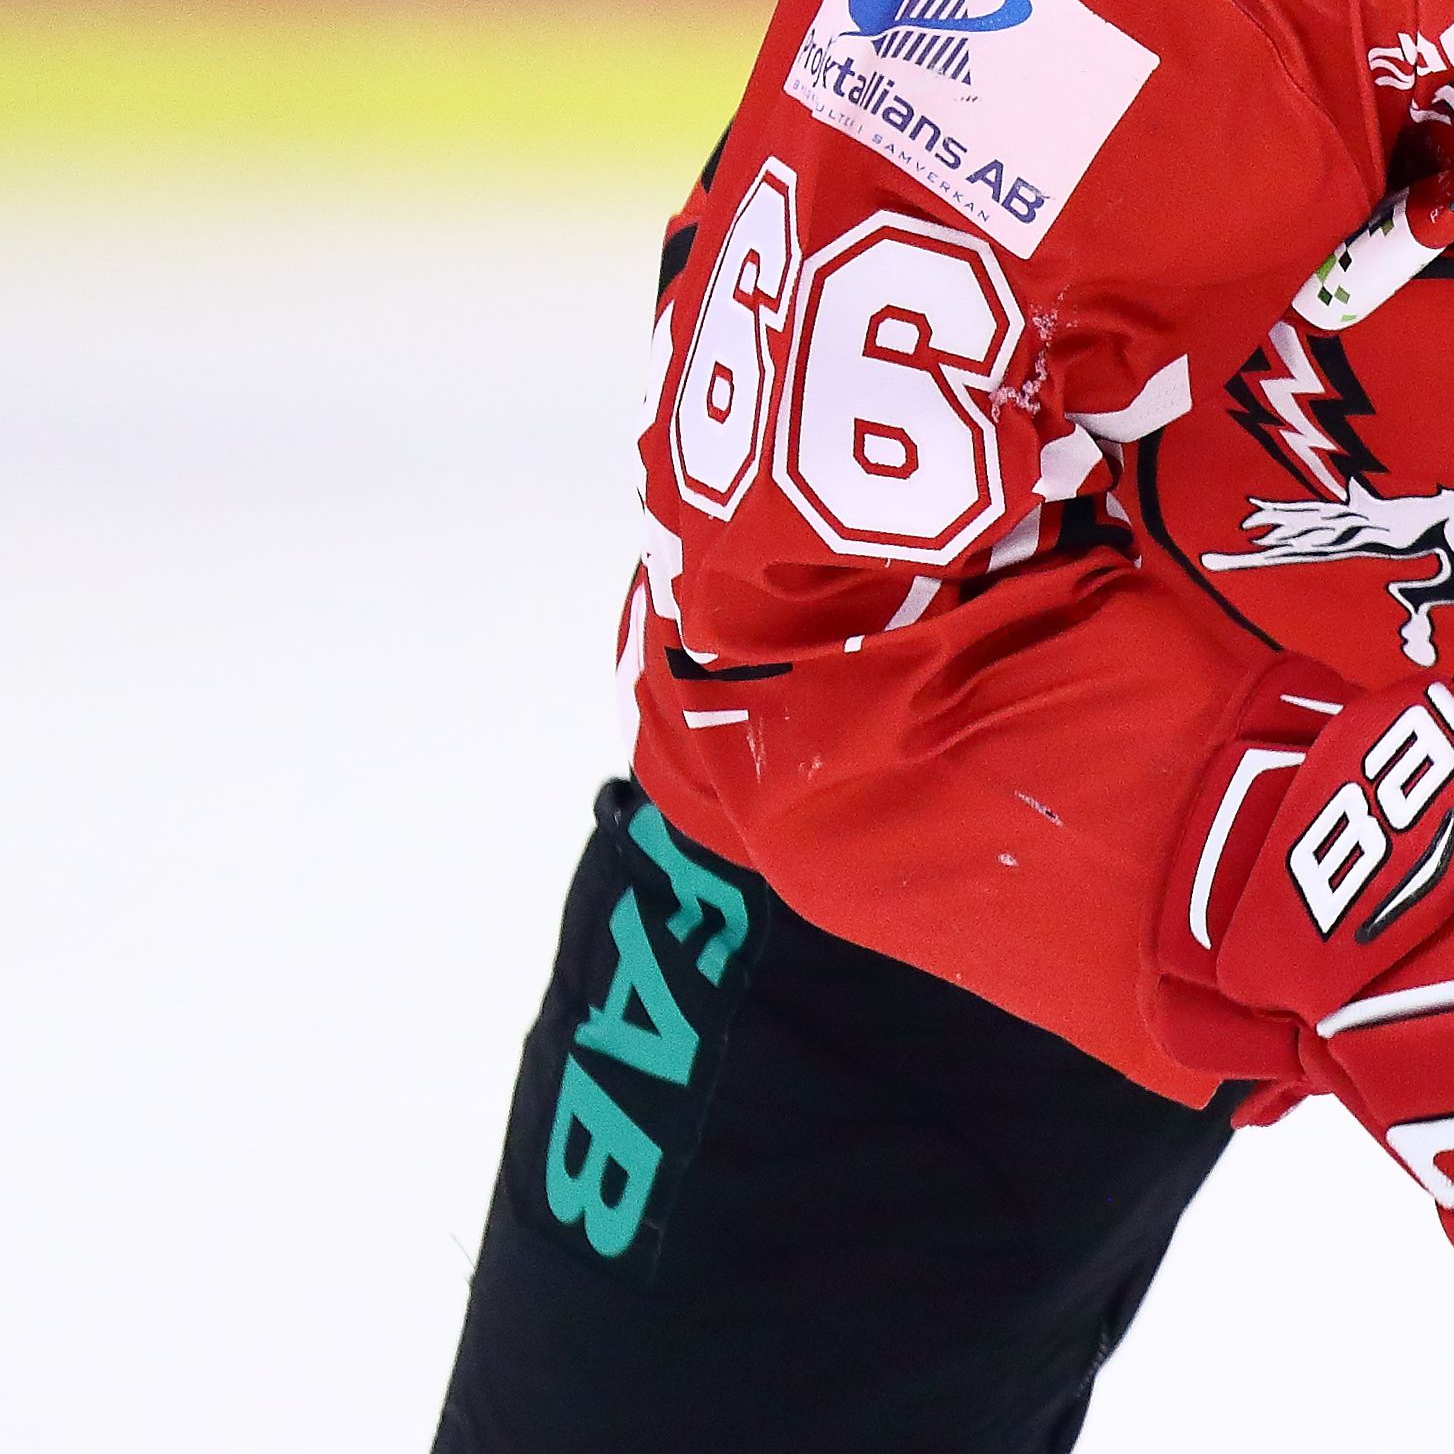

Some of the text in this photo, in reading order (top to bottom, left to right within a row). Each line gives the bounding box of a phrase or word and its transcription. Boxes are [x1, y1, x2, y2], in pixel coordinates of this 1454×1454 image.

[871, 132, 991, 223] SAMVERKAN
[965, 158, 1048, 225] AB
[668, 155, 1026, 566] 66
